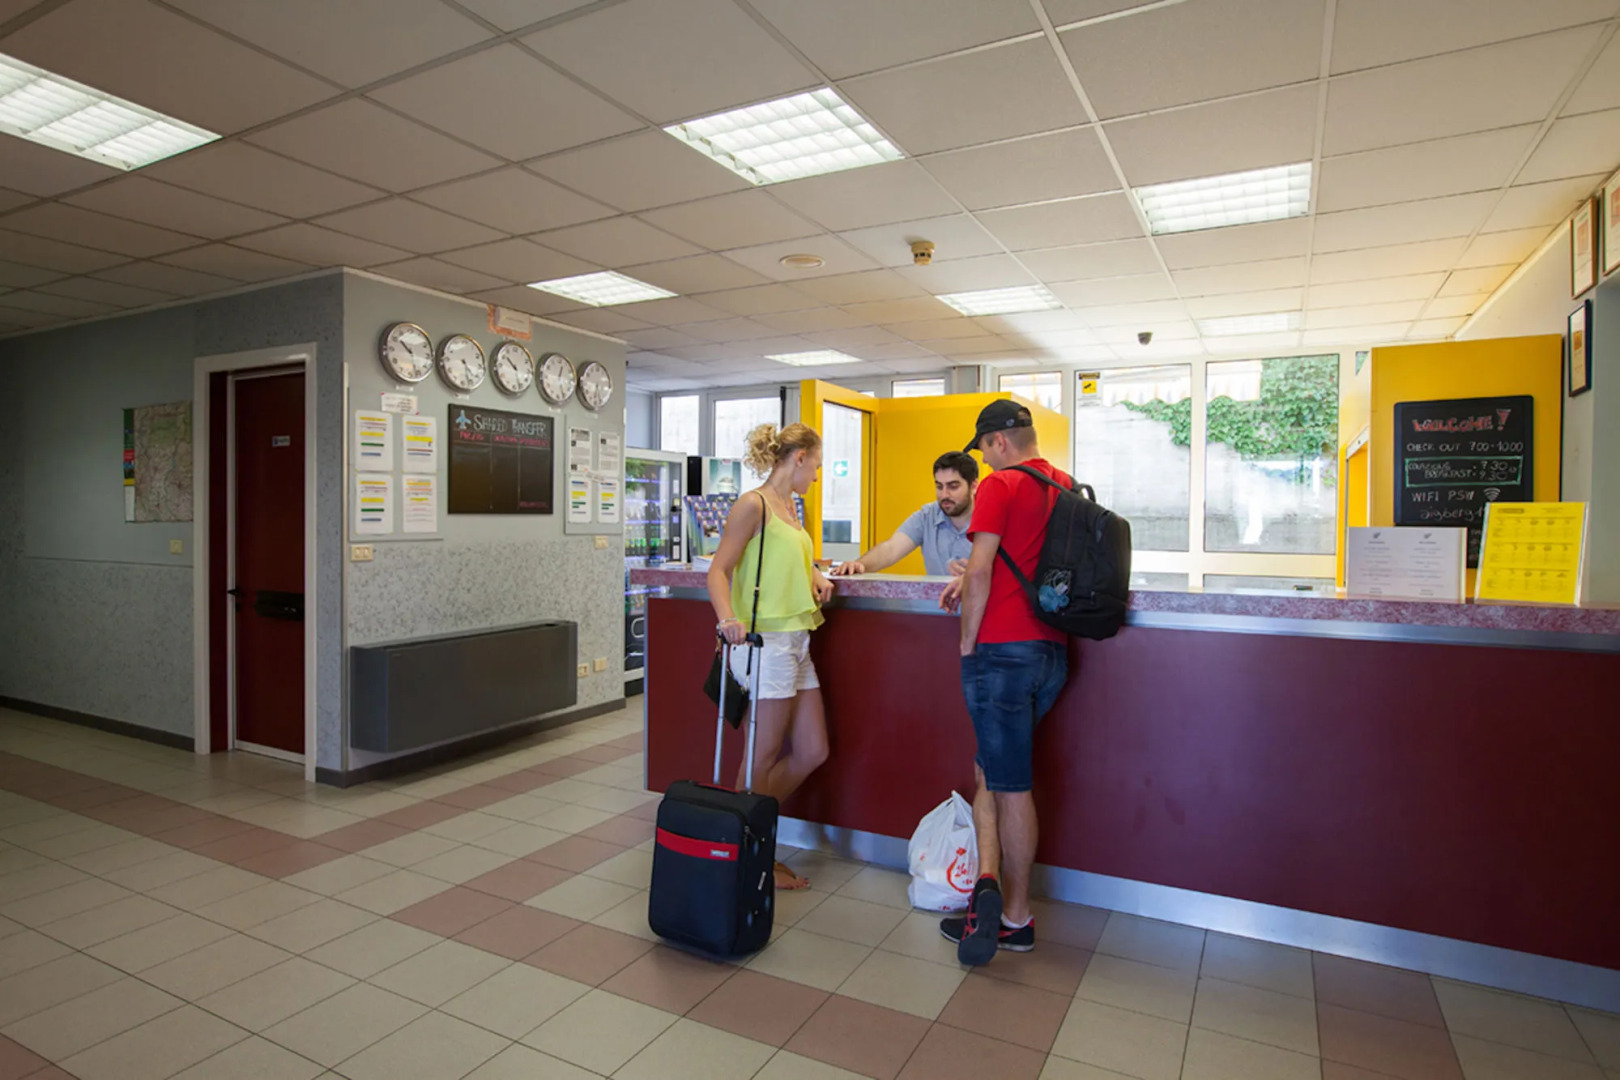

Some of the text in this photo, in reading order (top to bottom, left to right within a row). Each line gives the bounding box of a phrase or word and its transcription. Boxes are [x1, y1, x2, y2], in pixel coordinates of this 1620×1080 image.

[1438, 442, 1461, 453] OUT
[1411, 489, 1476, 502] WIFI PSW
